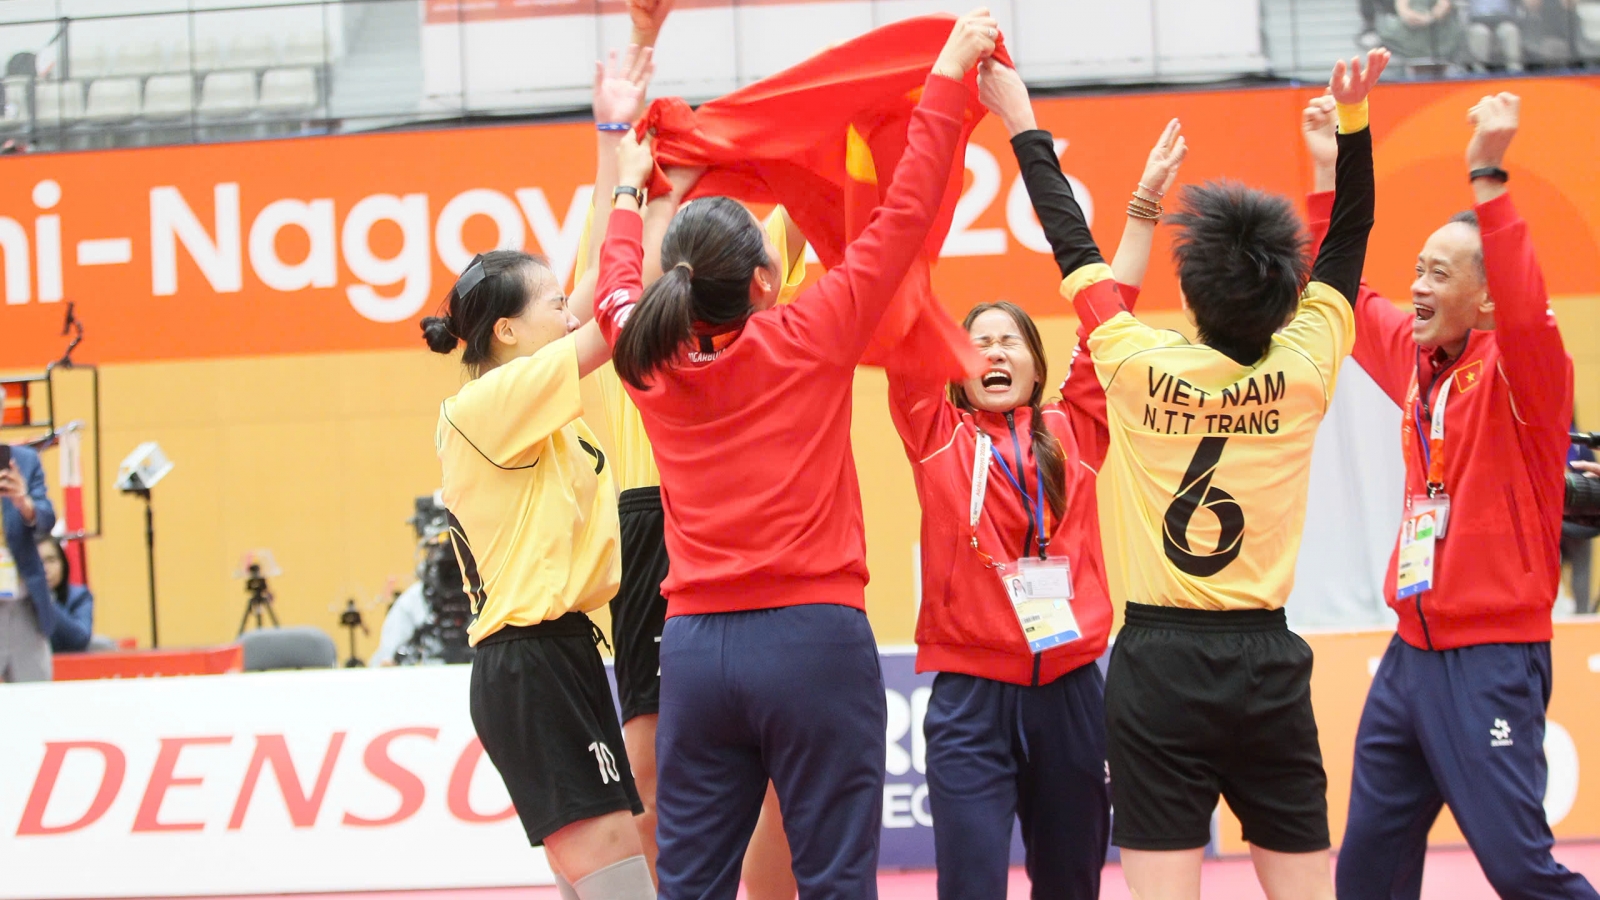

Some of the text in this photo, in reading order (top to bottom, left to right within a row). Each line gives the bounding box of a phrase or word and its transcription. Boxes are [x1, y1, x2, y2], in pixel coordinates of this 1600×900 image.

[939, 138, 1095, 258] 26
[1149, 365, 1286, 409] VIET NAM
[1204, 409, 1280, 435] TRANG
[1162, 437, 1245, 578] 6
[588, 741, 621, 785] 10
